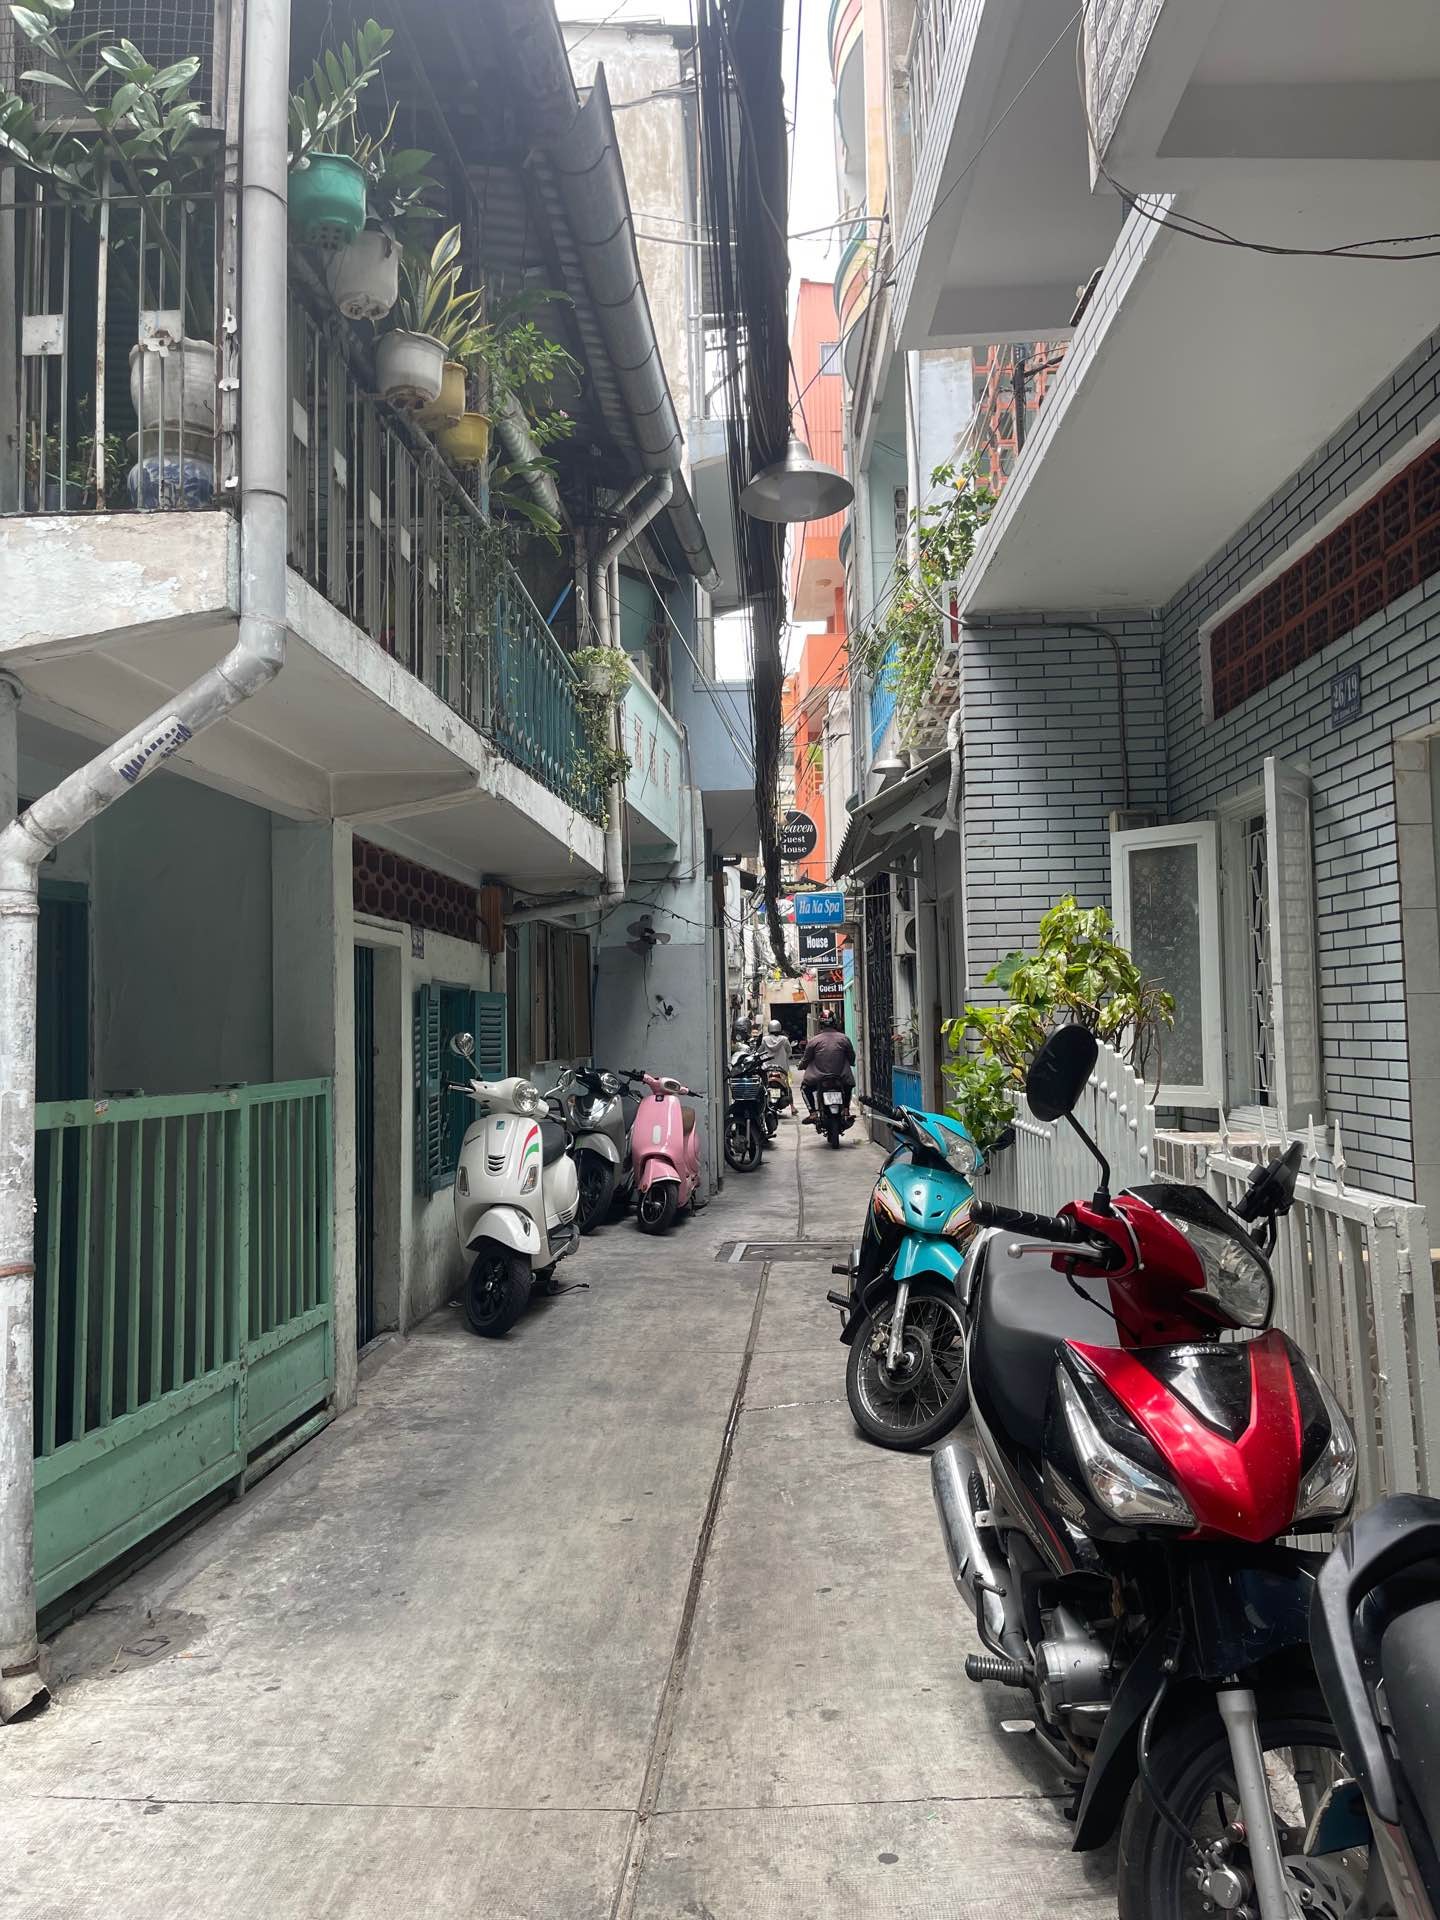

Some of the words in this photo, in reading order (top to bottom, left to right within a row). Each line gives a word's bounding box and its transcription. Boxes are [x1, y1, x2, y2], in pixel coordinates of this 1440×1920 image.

[799, 900, 811, 914] Ha
[812, 899, 824, 914] Na
[824, 899, 840, 916] Spa
[806, 935, 829, 949] House
[819, 984, 837, 993] Guest
[1052, 1497, 1091, 1530] HONDA
